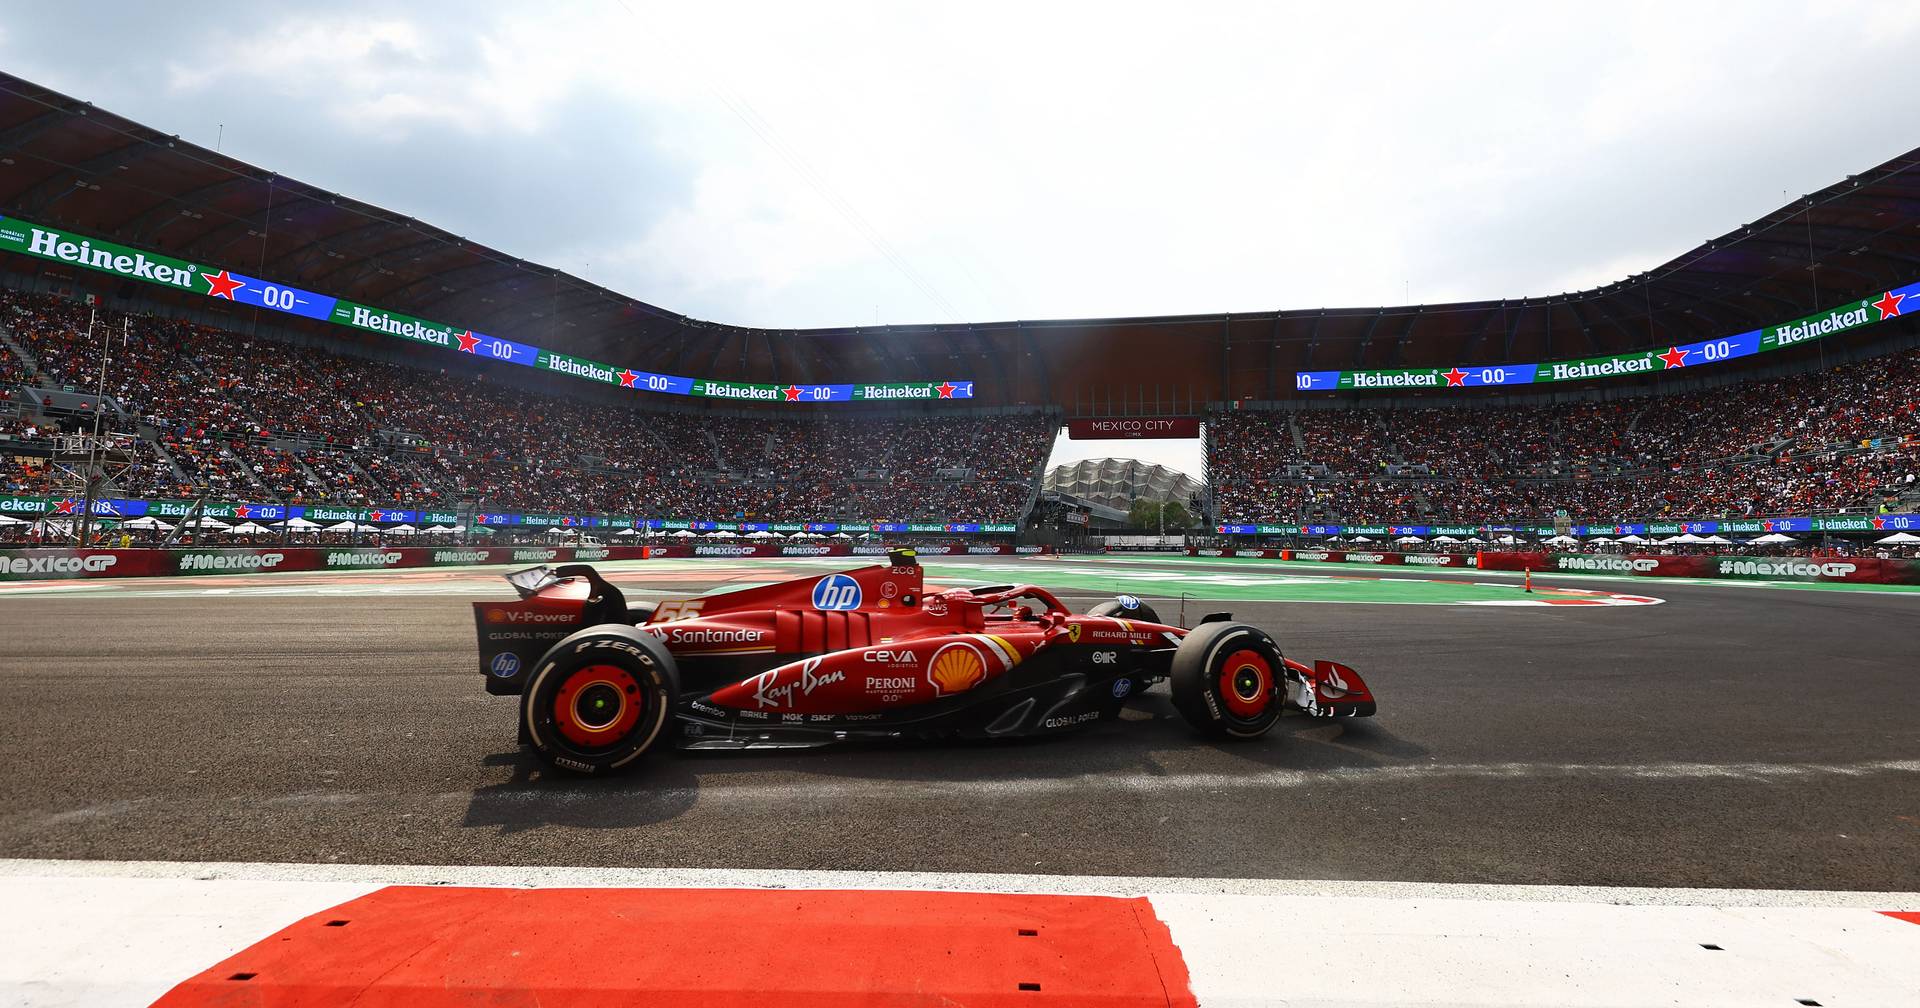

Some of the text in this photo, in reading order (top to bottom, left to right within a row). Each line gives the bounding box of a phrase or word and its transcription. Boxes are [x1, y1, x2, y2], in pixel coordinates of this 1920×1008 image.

[1092, 420, 1174, 431] MEXICO CITY
[434, 551, 489, 562] #MexicoGP
[695, 546, 757, 555] #MexicoGP
[179, 553, 284, 570] #MexicoGP
[327, 552, 402, 565] #MexicoGP
[1558, 557, 1660, 571] #MexicoGP
[1719, 560, 1857, 577] #MexicoGP
[818, 574, 857, 610] hp
[506, 611, 576, 622] V-Power
[654, 600, 706, 623] 55
[488, 632, 532, 640] GLOBAL
[671, 627, 765, 643] Santander
[1092, 631, 1127, 639] RICHARD
[576, 639, 654, 667] P ZERO
[496, 653, 516, 677] hp
[865, 677, 916, 689] PERONI
[691, 701, 726, 717] brembo
[740, 710, 768, 719] MAHLE
[782, 713, 803, 721] NGK
